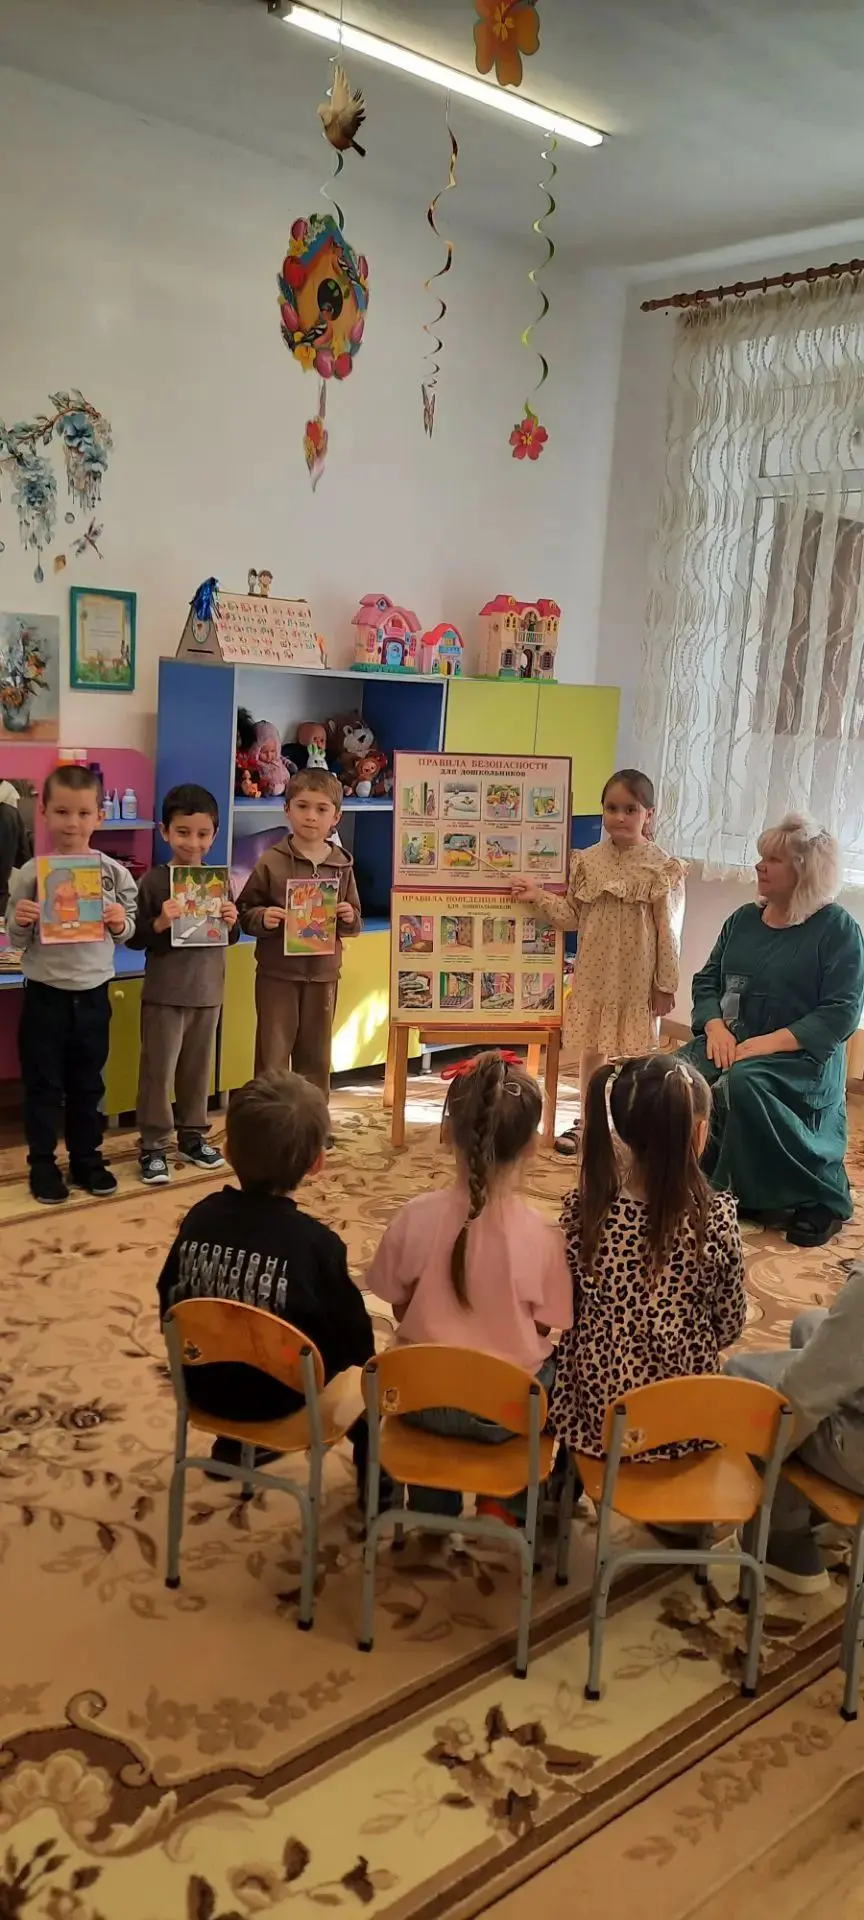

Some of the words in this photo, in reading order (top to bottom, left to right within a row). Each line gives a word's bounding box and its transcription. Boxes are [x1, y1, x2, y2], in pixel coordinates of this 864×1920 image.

[418, 758, 466, 767] ПРАВИЛА
[471, 760, 548, 770] БЕЗОПАСНОСТИ
[460, 769, 526, 777] ДОШКОЛЬНИКОВ
